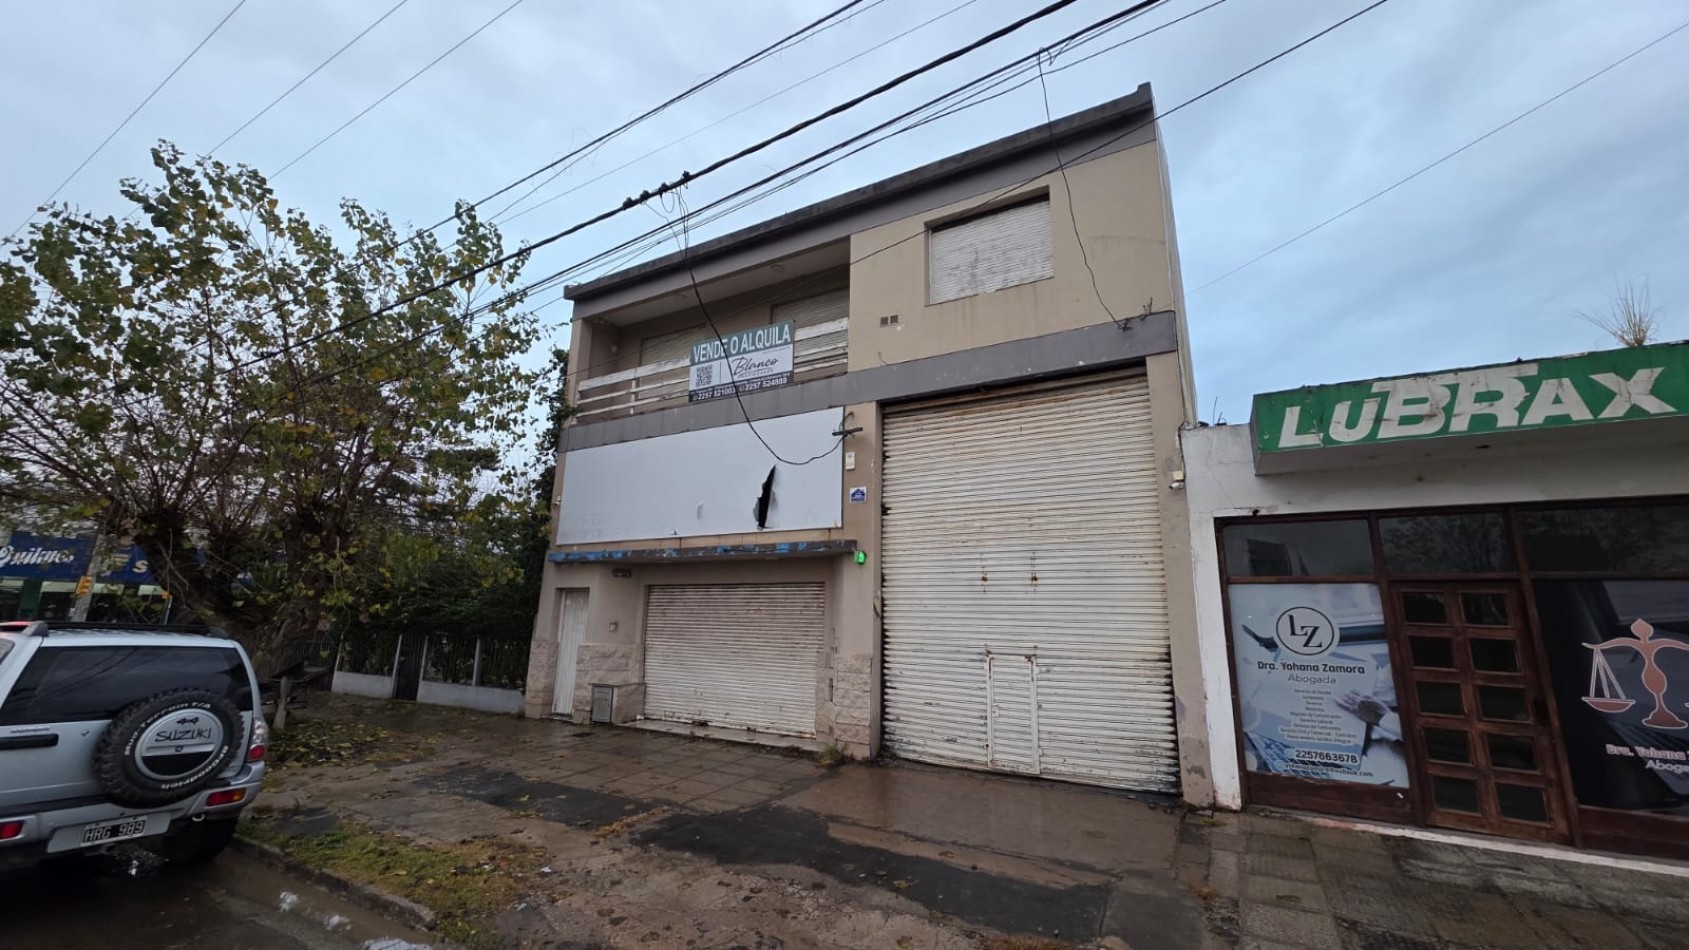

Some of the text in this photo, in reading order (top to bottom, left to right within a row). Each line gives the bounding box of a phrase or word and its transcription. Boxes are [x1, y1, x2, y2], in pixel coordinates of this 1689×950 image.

[693, 324, 791, 363] VENDE O ALQUILA
[731, 355, 778, 377] Blanco
[1277, 363, 1677, 448] LUBRAX
[1257, 660, 1366, 675] Dra. Yohana Zamora
[1287, 673, 1337, 685] Abogada
[154, 728, 213, 743] SUZUKI
[84, 820, 145, 842] HRG 989
